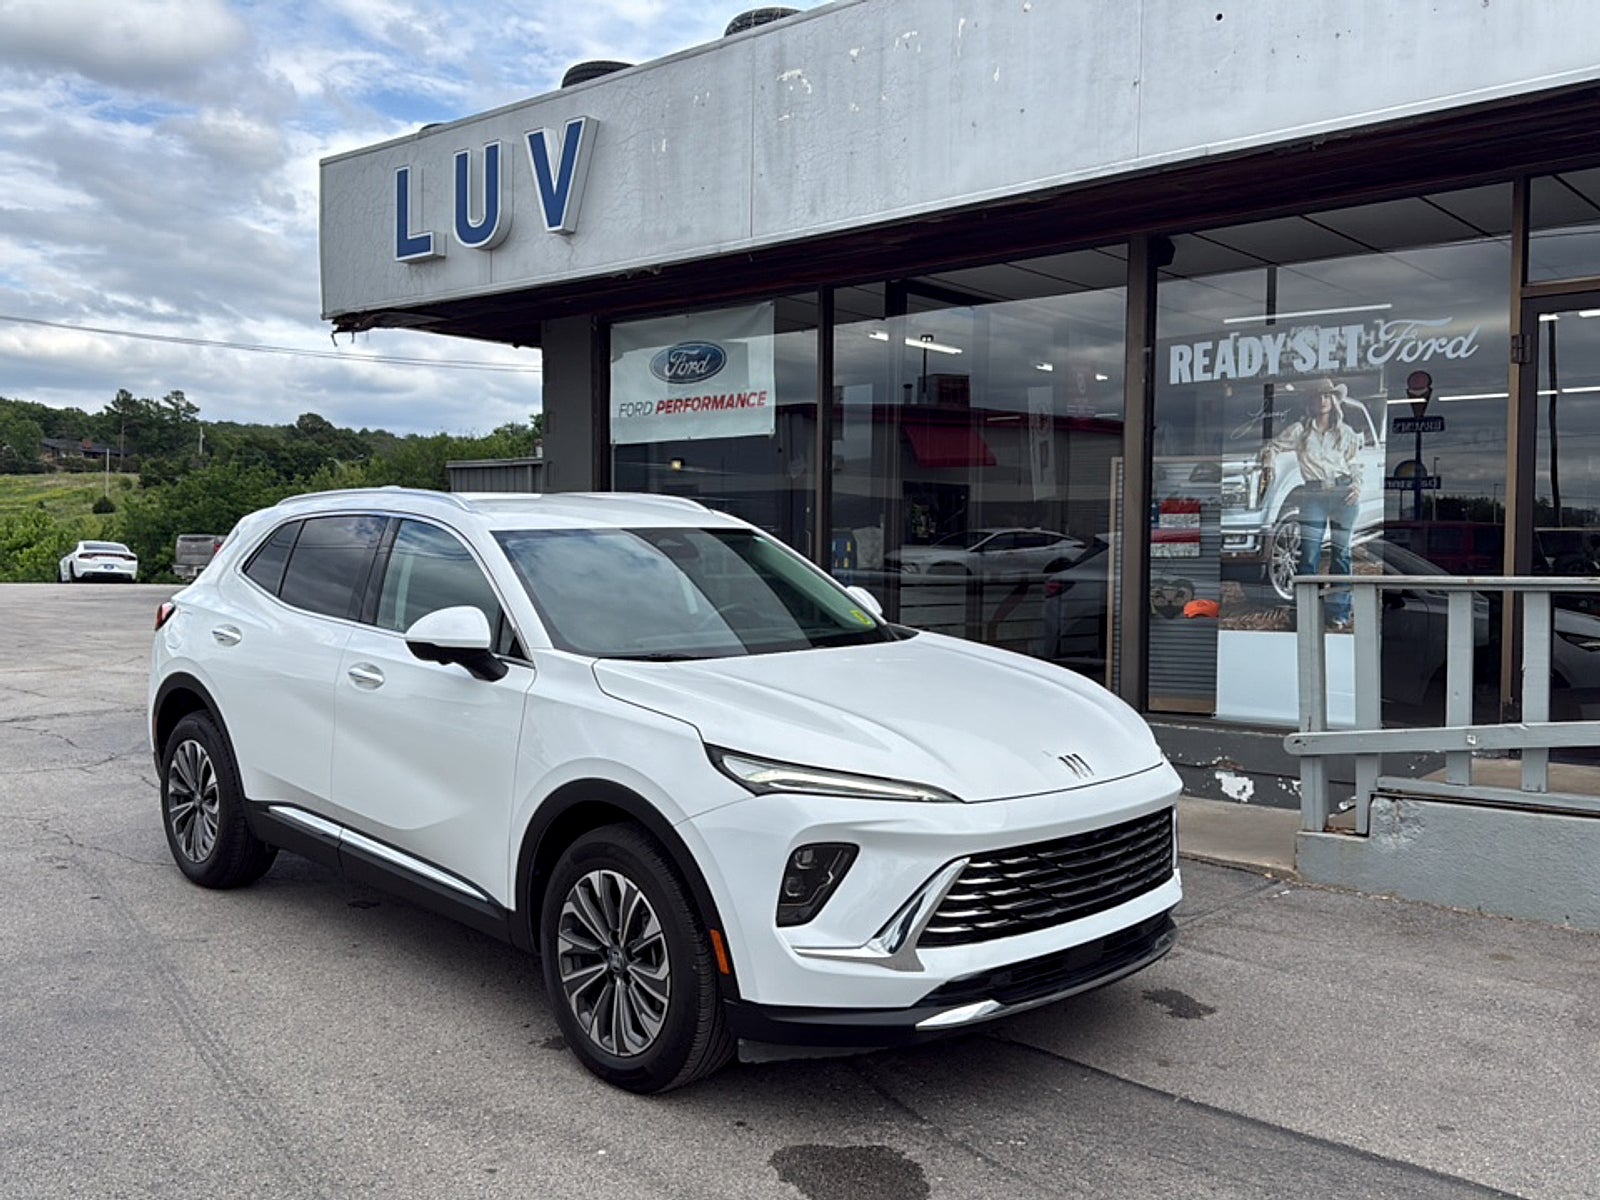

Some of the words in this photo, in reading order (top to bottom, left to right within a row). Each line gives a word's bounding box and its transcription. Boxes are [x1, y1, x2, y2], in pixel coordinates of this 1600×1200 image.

[394, 116, 600, 264] LUV
[664, 349, 713, 377] Ford
[1170, 333, 1286, 384] READY
[1293, 324, 1364, 373] SET
[1367, 317, 1480, 364] Ford
[619, 401, 653, 418] FORD
[655, 390, 768, 415] PERFORMANCE
